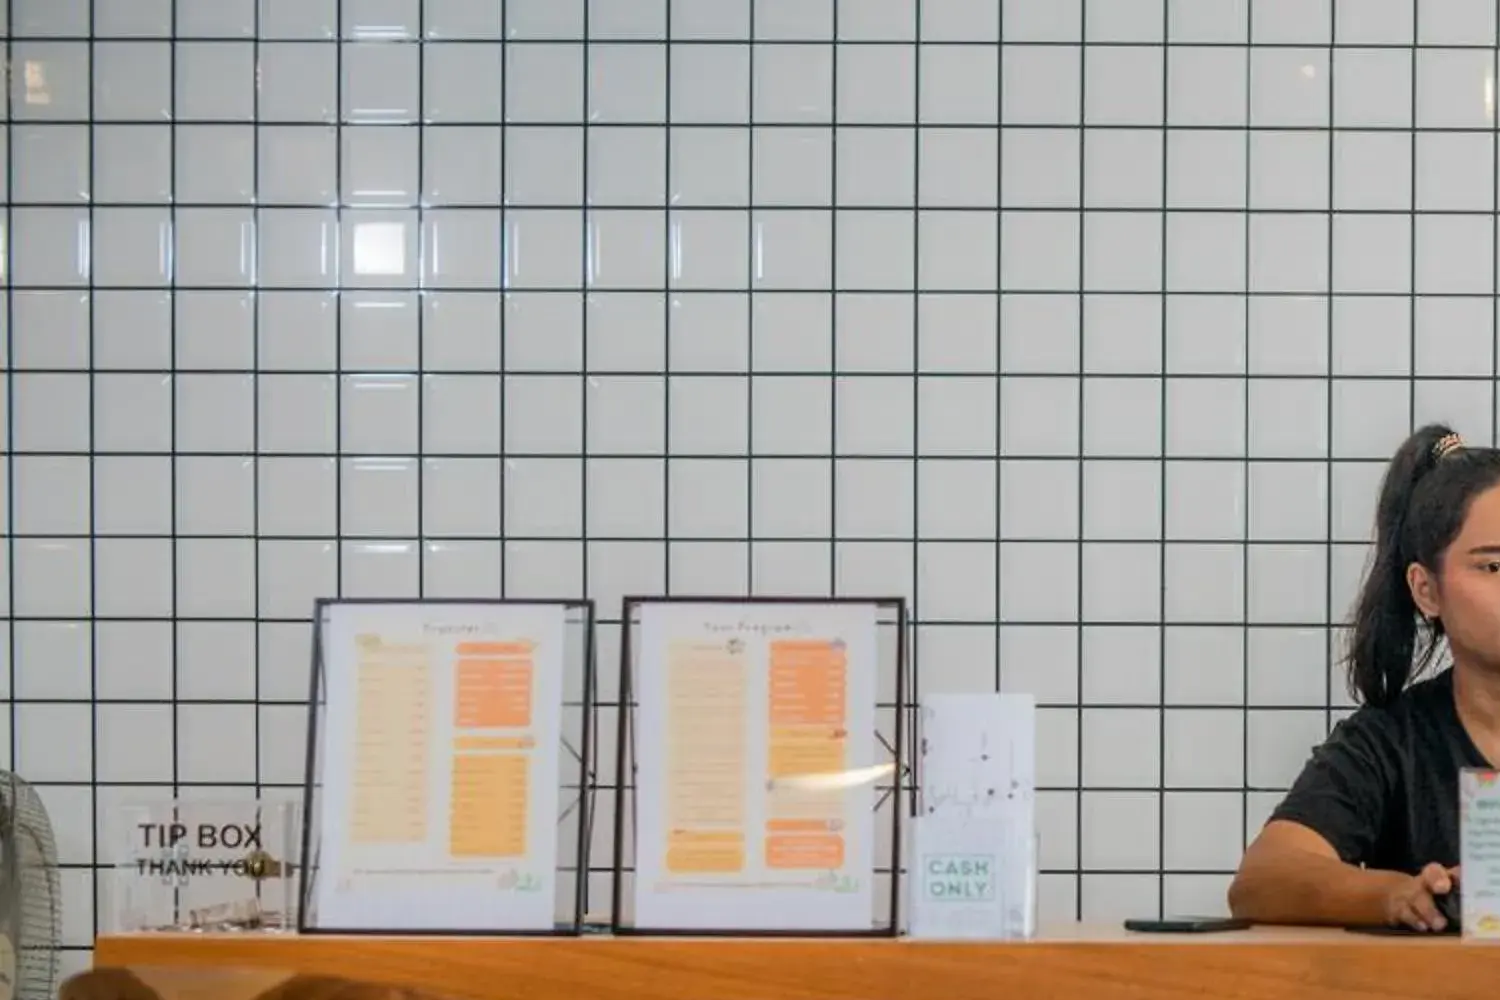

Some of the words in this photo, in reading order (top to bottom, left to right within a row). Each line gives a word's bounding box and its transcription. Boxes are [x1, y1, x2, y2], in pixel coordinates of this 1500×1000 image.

[138, 823, 187, 848] TIP
[198, 823, 263, 849] BOX
[136, 857, 213, 877] THANK
[218, 857, 266, 877] YOU
[928, 860, 990, 876] CASH
[929, 881, 988, 897] ONLY
